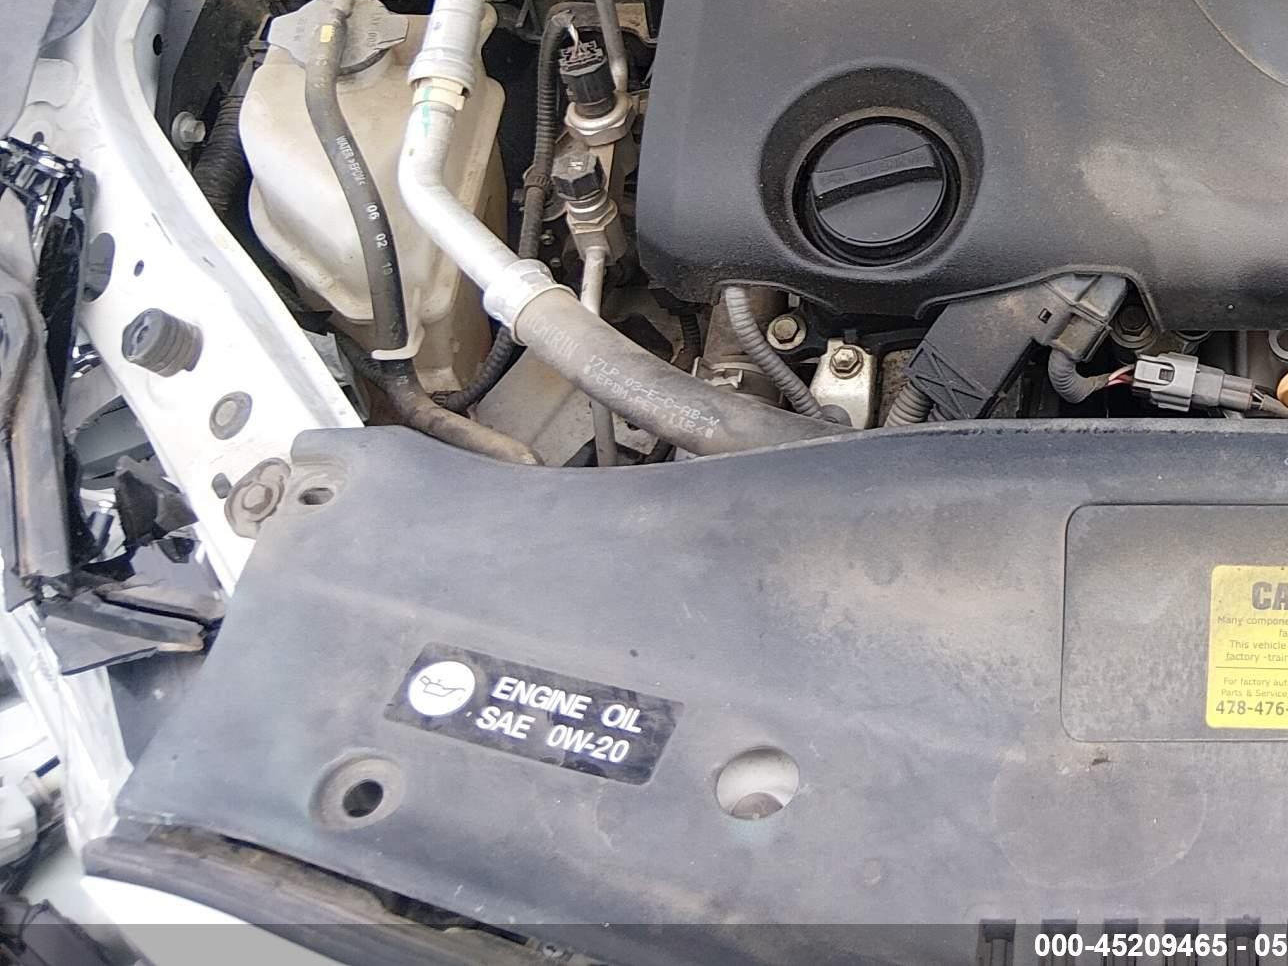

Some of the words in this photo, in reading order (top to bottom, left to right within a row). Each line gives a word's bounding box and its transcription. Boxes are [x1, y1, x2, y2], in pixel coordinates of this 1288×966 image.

[375, 233, 389, 249] 02
[1217, 615, 1242, 626] Many
[1230, 640, 1249, 649] This
[1253, 640, 1286, 650] vehicle
[1225, 652, 1260, 663] factory
[1223, 677, 1238, 686] For
[1240, 677, 1270, 687] factory
[1221, 688, 1243, 697] Parts
[491, 676, 593, 720] ENGINE
[600, 703, 643, 734] OIL
[476, 705, 537, 740] SAE
[546, 724, 631, 764] 0W-20
